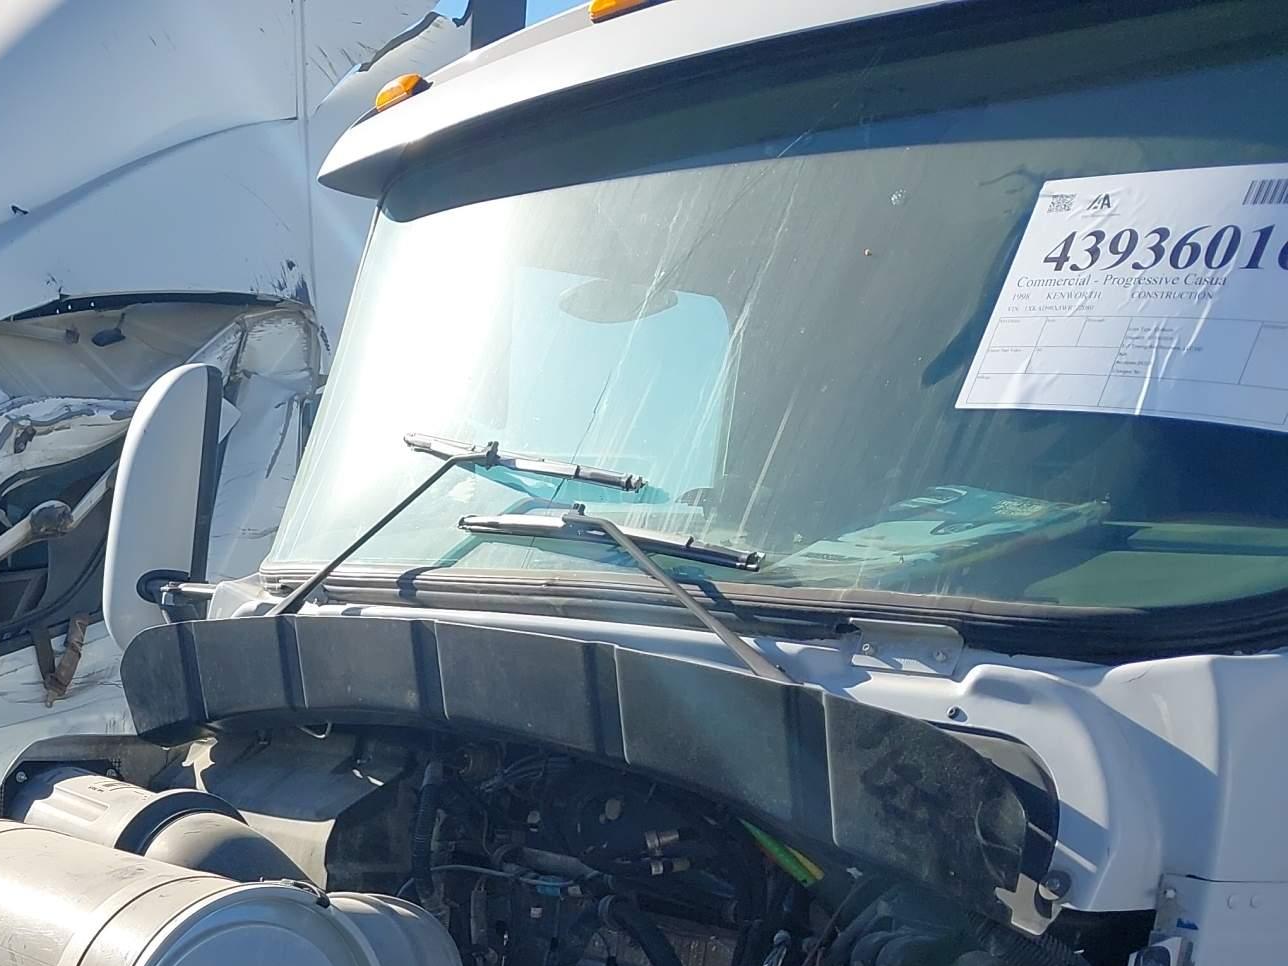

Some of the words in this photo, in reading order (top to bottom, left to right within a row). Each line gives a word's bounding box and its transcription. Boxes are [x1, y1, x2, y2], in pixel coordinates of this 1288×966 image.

[1043, 223, 1288, 271] 4393601
[1017, 274, 1091, 287] Commercial
[1103, 273, 1179, 288] Progressive
[1184, 273, 1227, 286] Casua
[1046, 291, 1102, 300] KENWORTH
[1131, 291, 1213, 300] CONSTRUCTION
